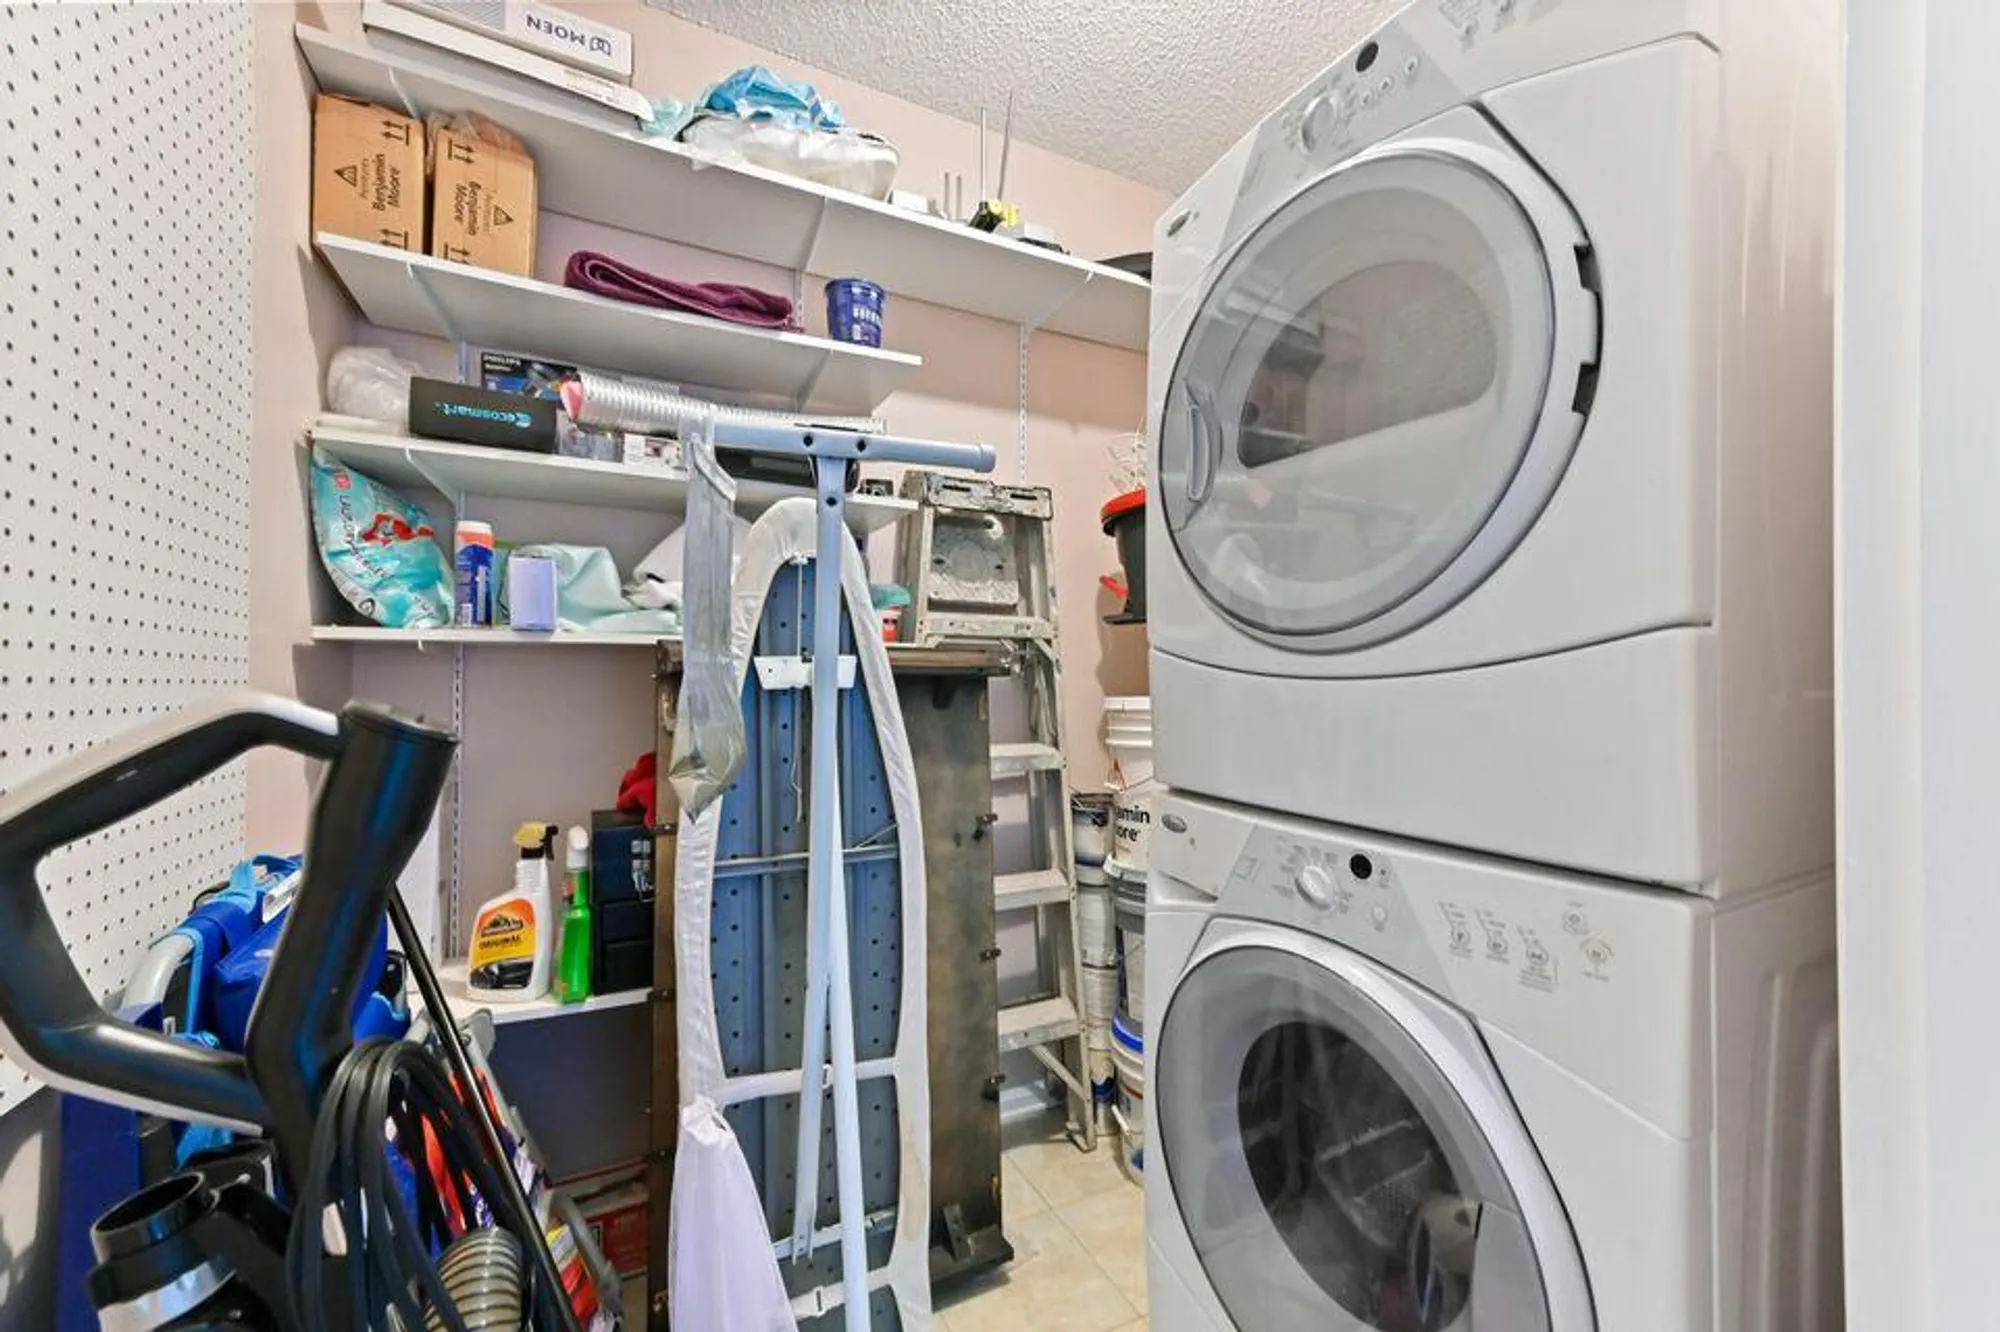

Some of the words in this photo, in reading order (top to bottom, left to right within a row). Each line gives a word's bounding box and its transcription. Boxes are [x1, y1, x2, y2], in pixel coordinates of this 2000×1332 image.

[526, 14, 586, 46] MOEN
[371, 152, 387, 212] Benjamin
[387, 164, 401, 208] Moore
[454, 182, 468, 224] Moore
[466, 181, 482, 236] Benjamin
[442, 402, 517, 425] ecosmart
[1115, 805, 1151, 824] amin
[1115, 825, 1138, 842] ore
